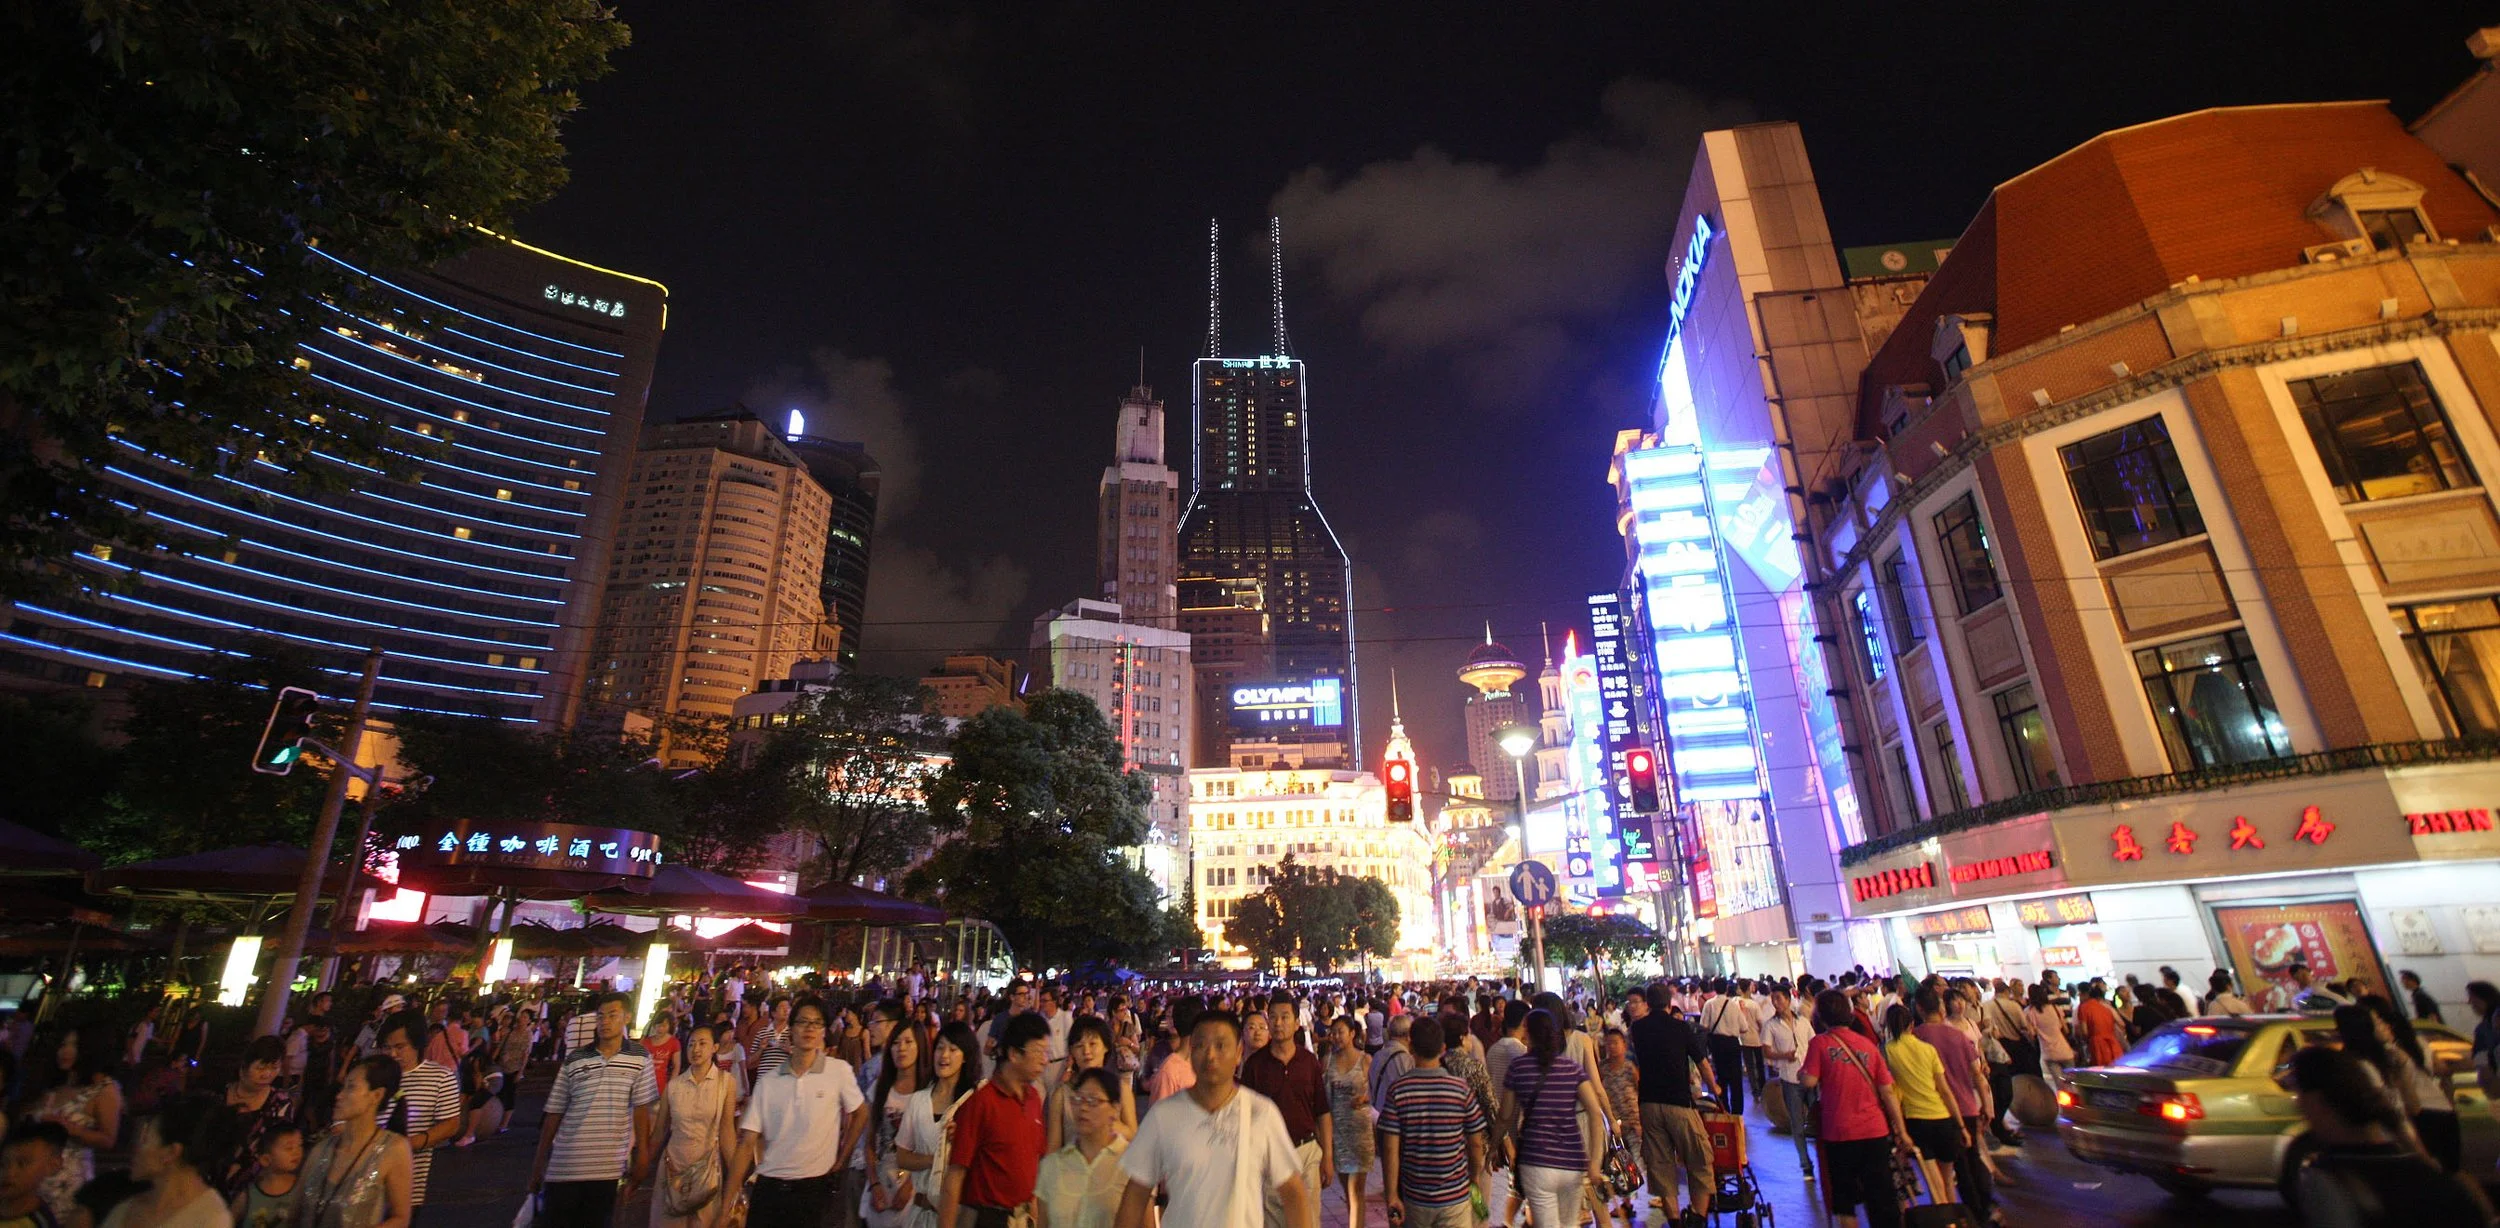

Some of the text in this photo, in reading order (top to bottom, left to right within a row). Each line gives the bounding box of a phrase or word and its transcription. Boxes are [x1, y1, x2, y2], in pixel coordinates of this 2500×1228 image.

[1670, 213, 1711, 335] NOKIA
[1259, 355, 1291, 369] 世茂
[1634, 685, 1643, 697] 5
[2404, 807, 2494, 835] ZHEN
